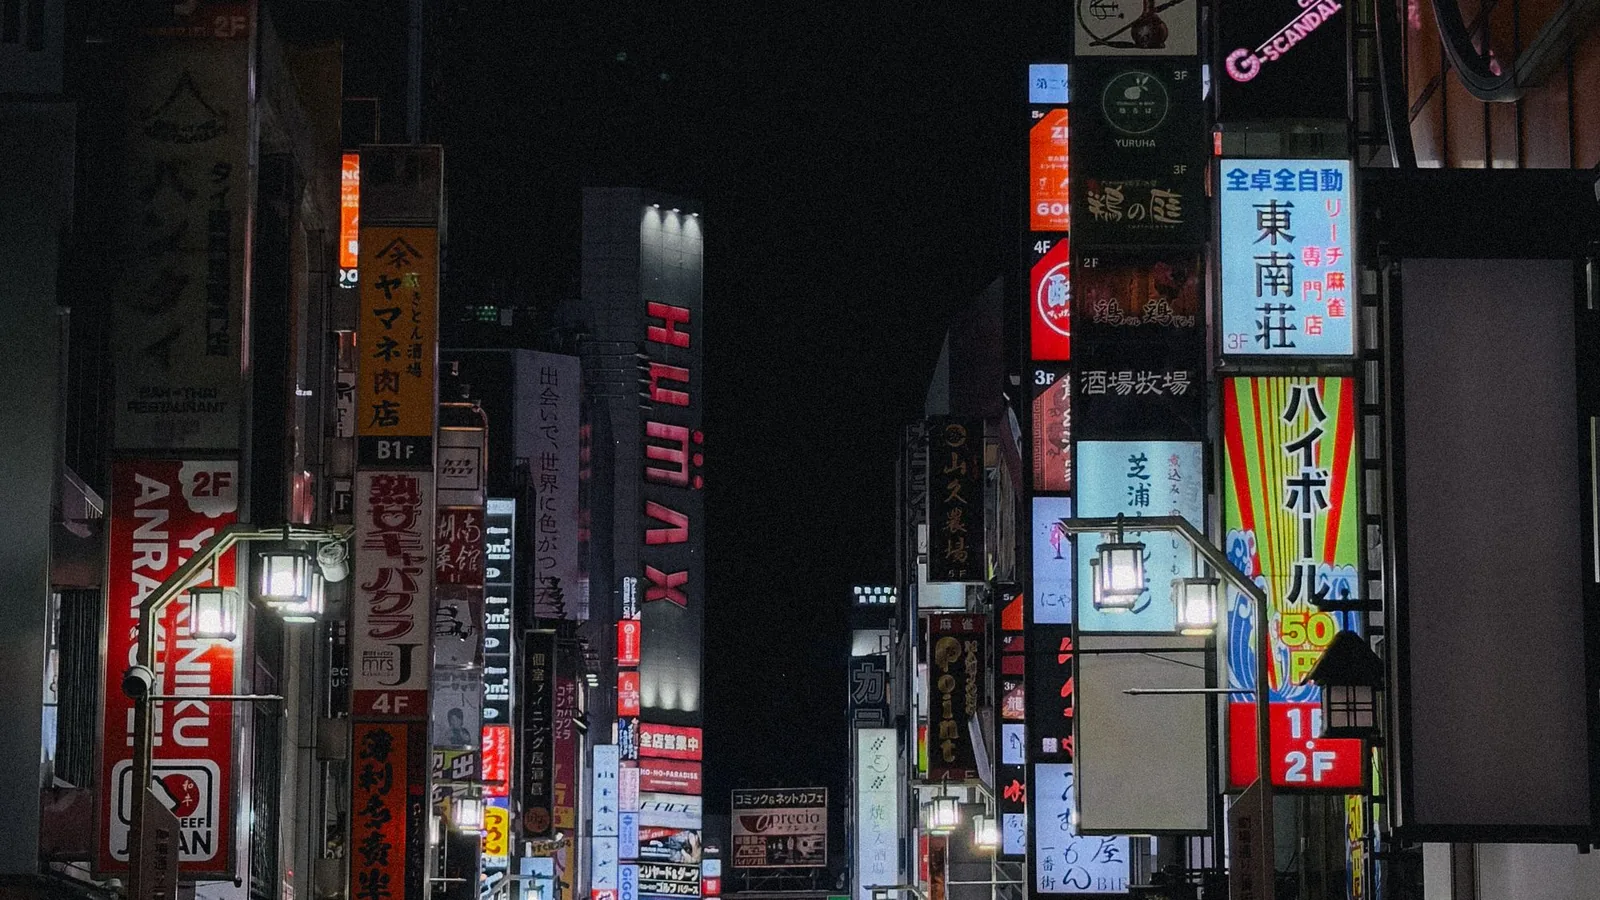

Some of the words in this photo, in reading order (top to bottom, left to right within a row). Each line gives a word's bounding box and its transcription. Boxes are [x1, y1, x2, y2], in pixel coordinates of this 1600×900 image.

[1174, 71, 1188, 80] 3F
[1115, 139, 1156, 148] YURUHA
[1173, 165, 1188, 175] 3F
[1226, 168, 1343, 193] 全卓全自動
[1034, 241, 1051, 254] 4F
[1326, 198, 1346, 319] リーチ麻雀
[1083, 258, 1099, 268] 2F
[1252, 199, 1297, 350] 東南荘
[1303, 247, 1323, 336] 専門店
[371, 275, 401, 428] ヤマネ肉店
[1228, 333, 1249, 349] 3F
[1034, 370, 1055, 385] 3F
[1081, 370, 1191, 396] 酒場牧場
[192, 472, 231, 497] 2F
[1282, 384, 1331, 607] ハイボール
[362, 474, 427, 641] 熟女キャバクラ
[940, 617, 974, 630] 麻雀
[1280, 613, 1335, 648] 50
[362, 656, 394, 671] mrs
[372, 693, 408, 713] 4F
[935, 636, 962, 763] Point
[640, 731, 699, 752] 全店営業中
[1285, 751, 1337, 782] 2F
[735, 792, 824, 805] コミック&ネットカフェ
[181, 818, 204, 828] EEF
[1041, 847, 1056, 890] 一番街
